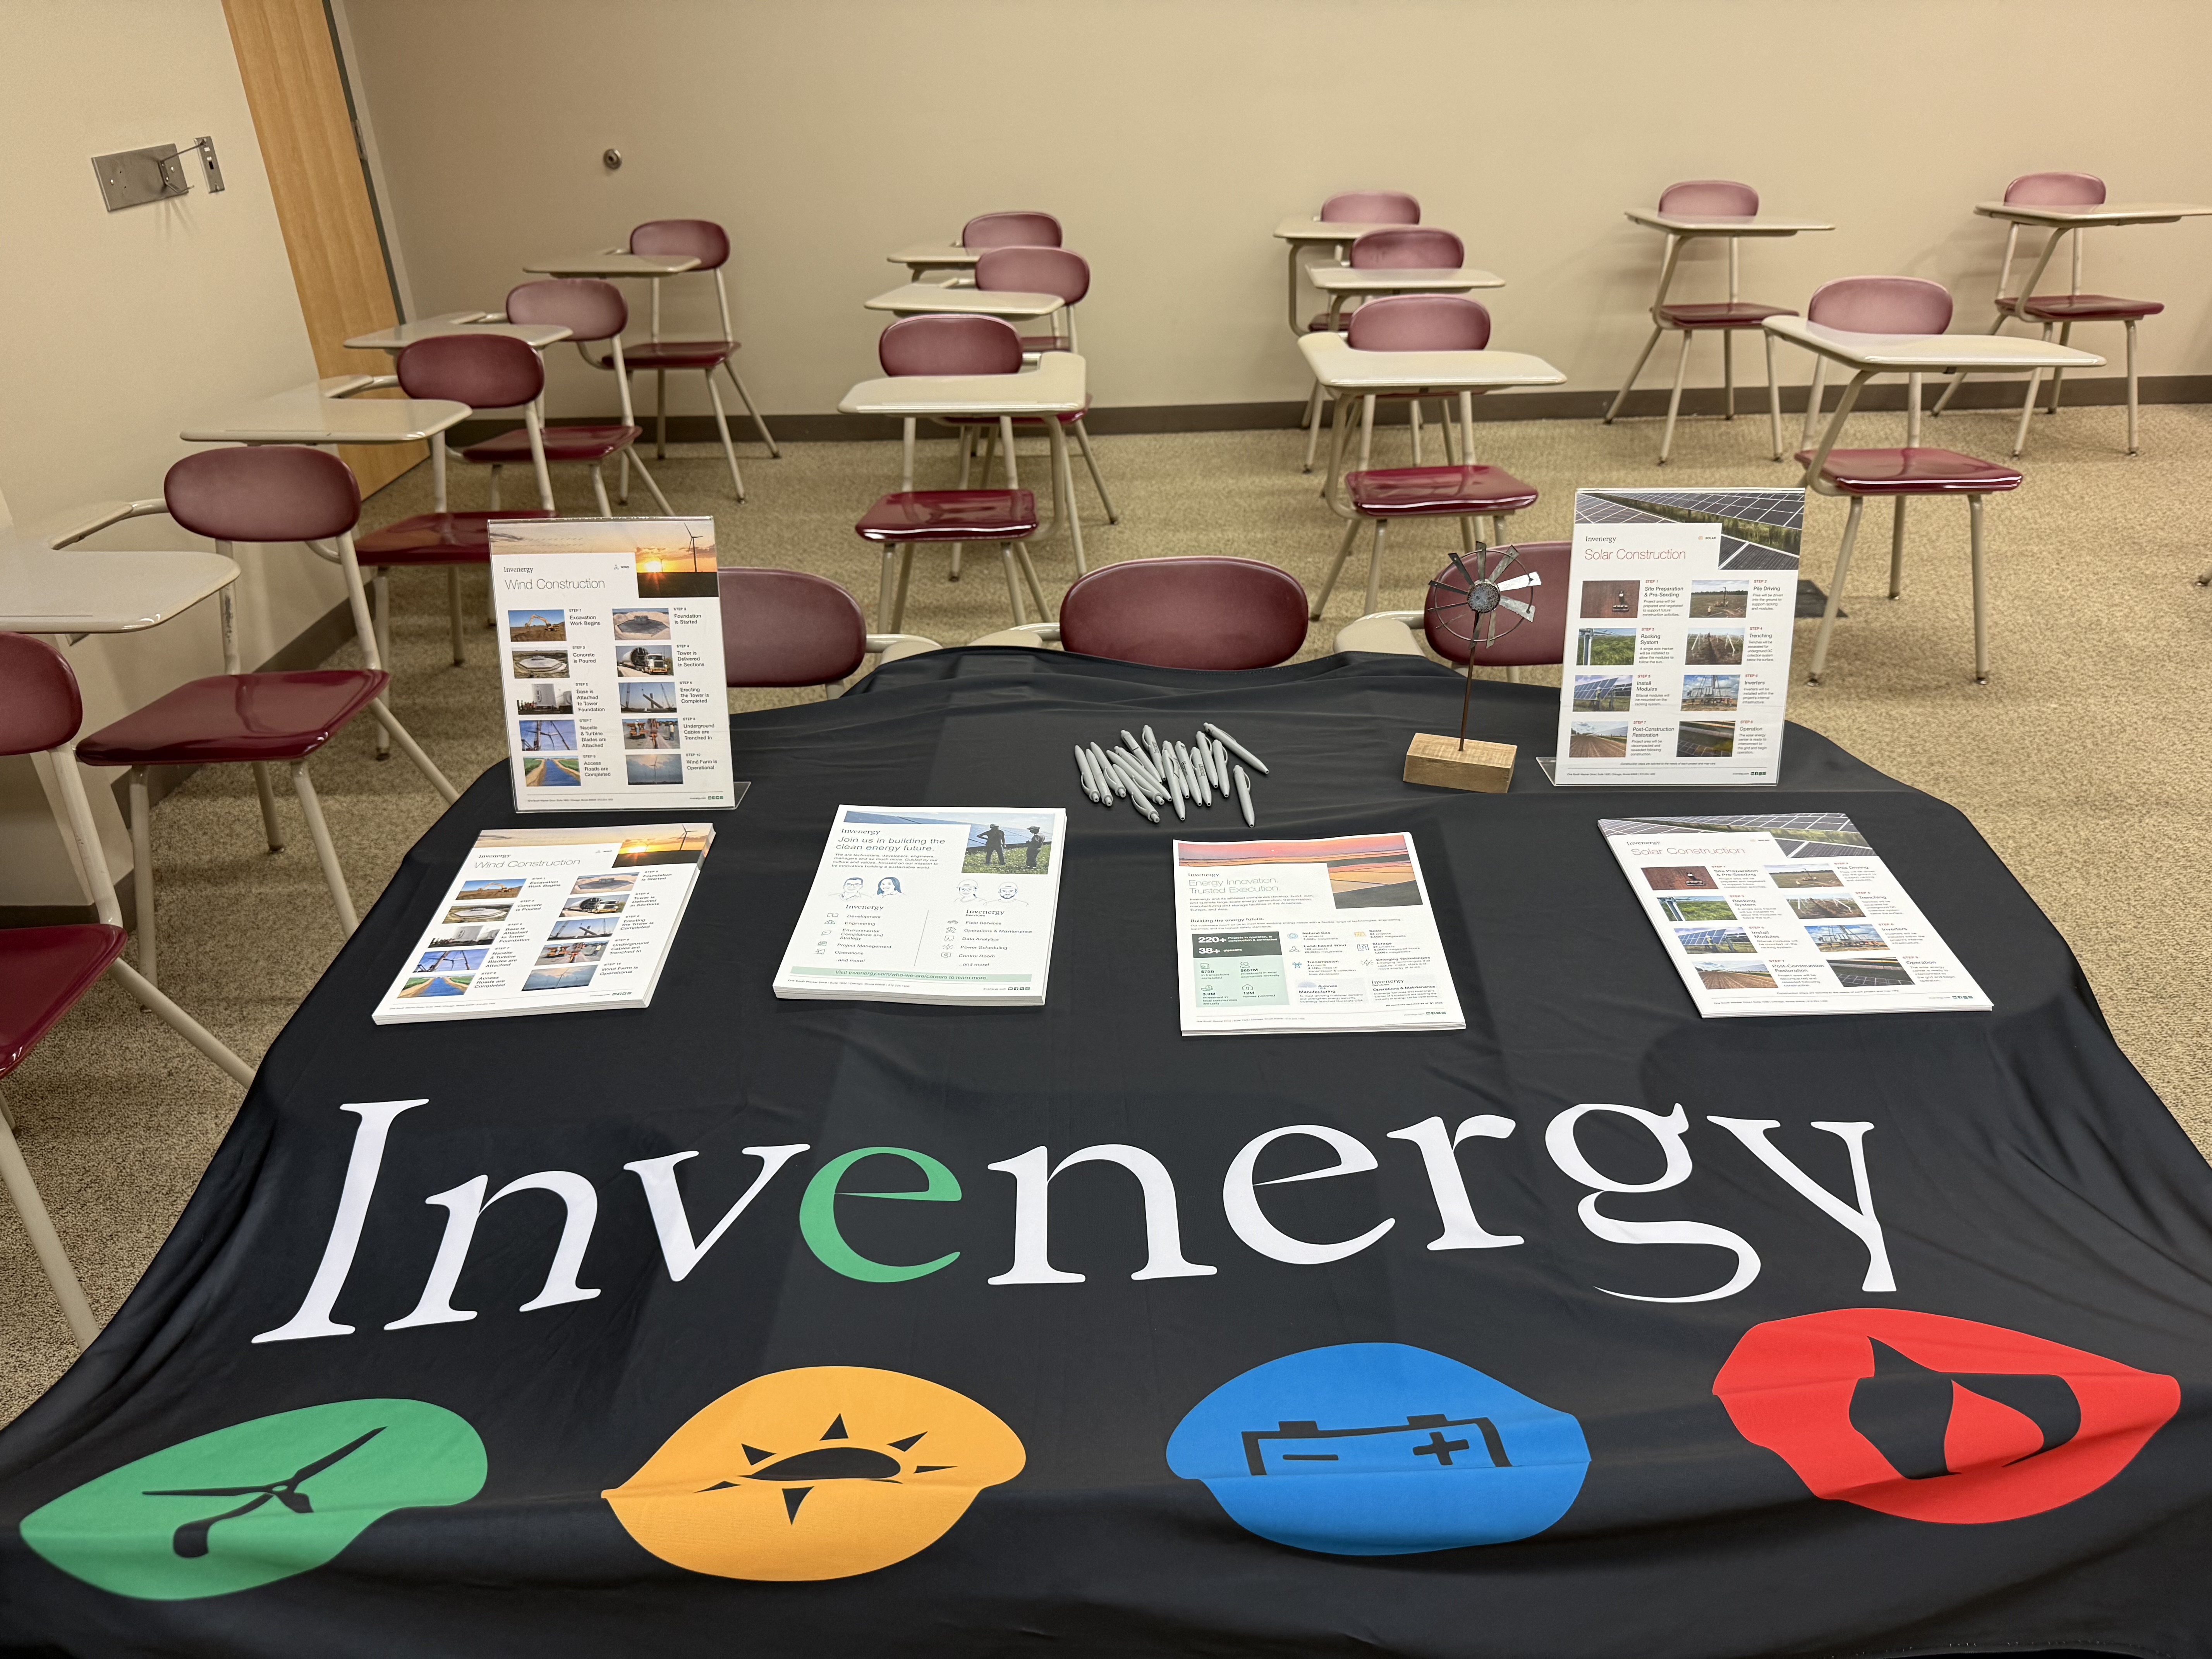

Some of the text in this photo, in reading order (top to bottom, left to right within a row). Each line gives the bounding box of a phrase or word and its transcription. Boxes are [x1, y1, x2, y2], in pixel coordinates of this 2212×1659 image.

[1585, 548, 1686, 560] Solar Construction
[505, 578, 605, 590] Wind Construction
[848, 970, 948, 979] invenergy.com/who-we-are/careers
[251, 1099, 1897, 1343] Invenergy
